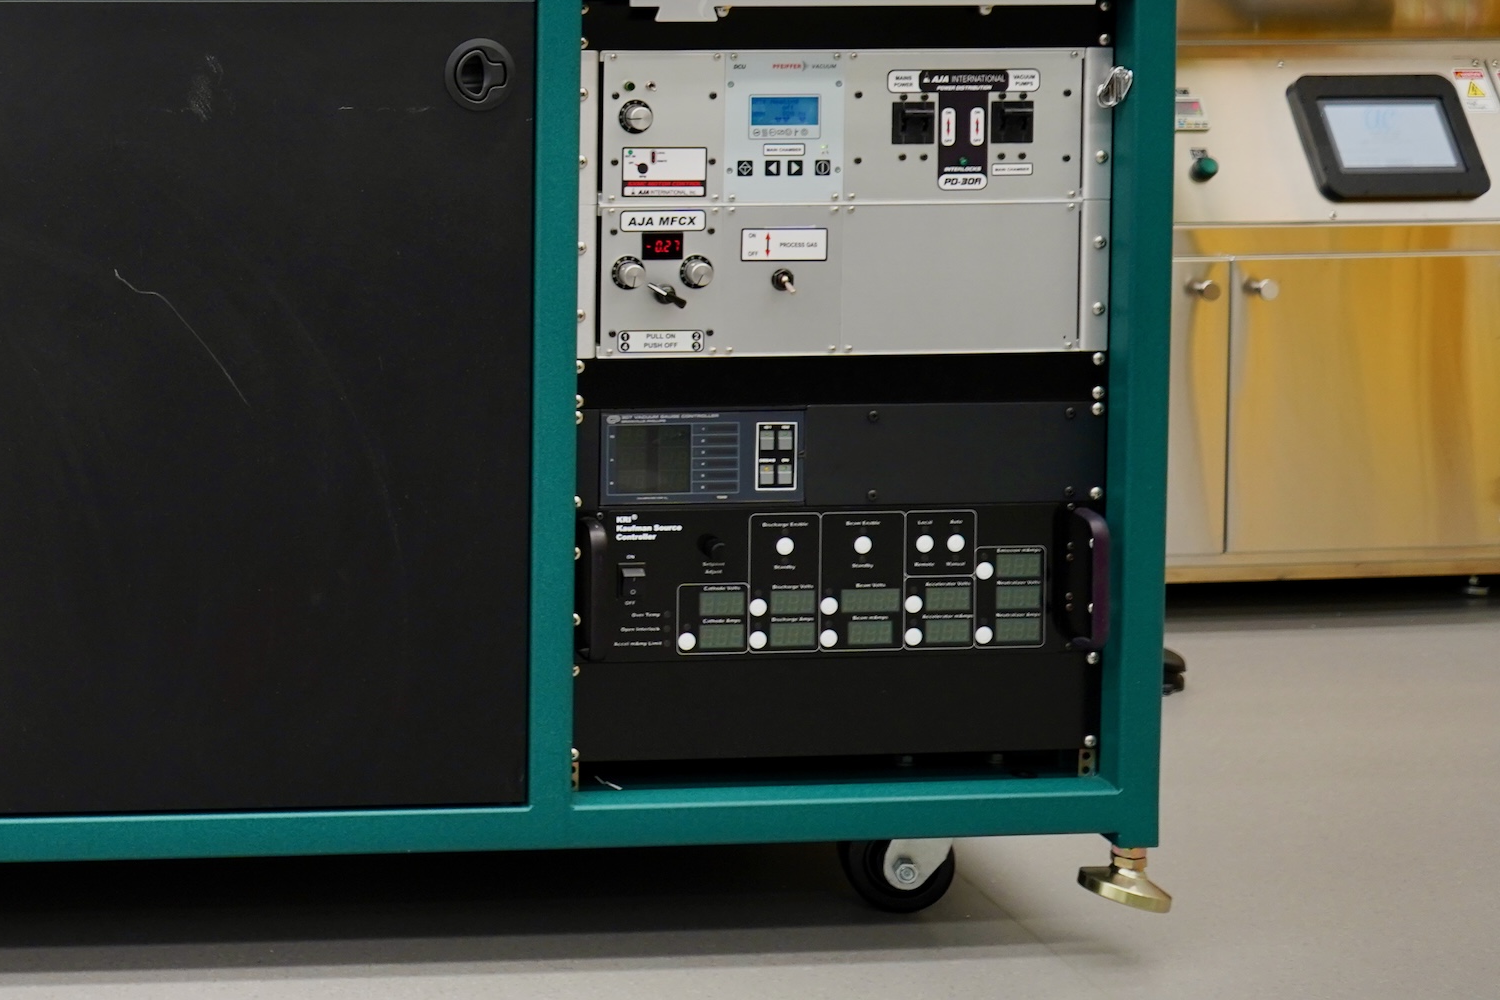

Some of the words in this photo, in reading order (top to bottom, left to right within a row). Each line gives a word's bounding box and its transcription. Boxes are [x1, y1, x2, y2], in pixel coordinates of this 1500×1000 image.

[931, 75, 950, 83] AJA
[951, 74, 1006, 83] INTERNATIONAL
[628, 217, 654, 226] AJA
[659, 216, 697, 226] MFCX
[616, 524, 653, 533] Kaufman
[653, 523, 683, 532] Source
[615, 533, 657, 541] Controller
